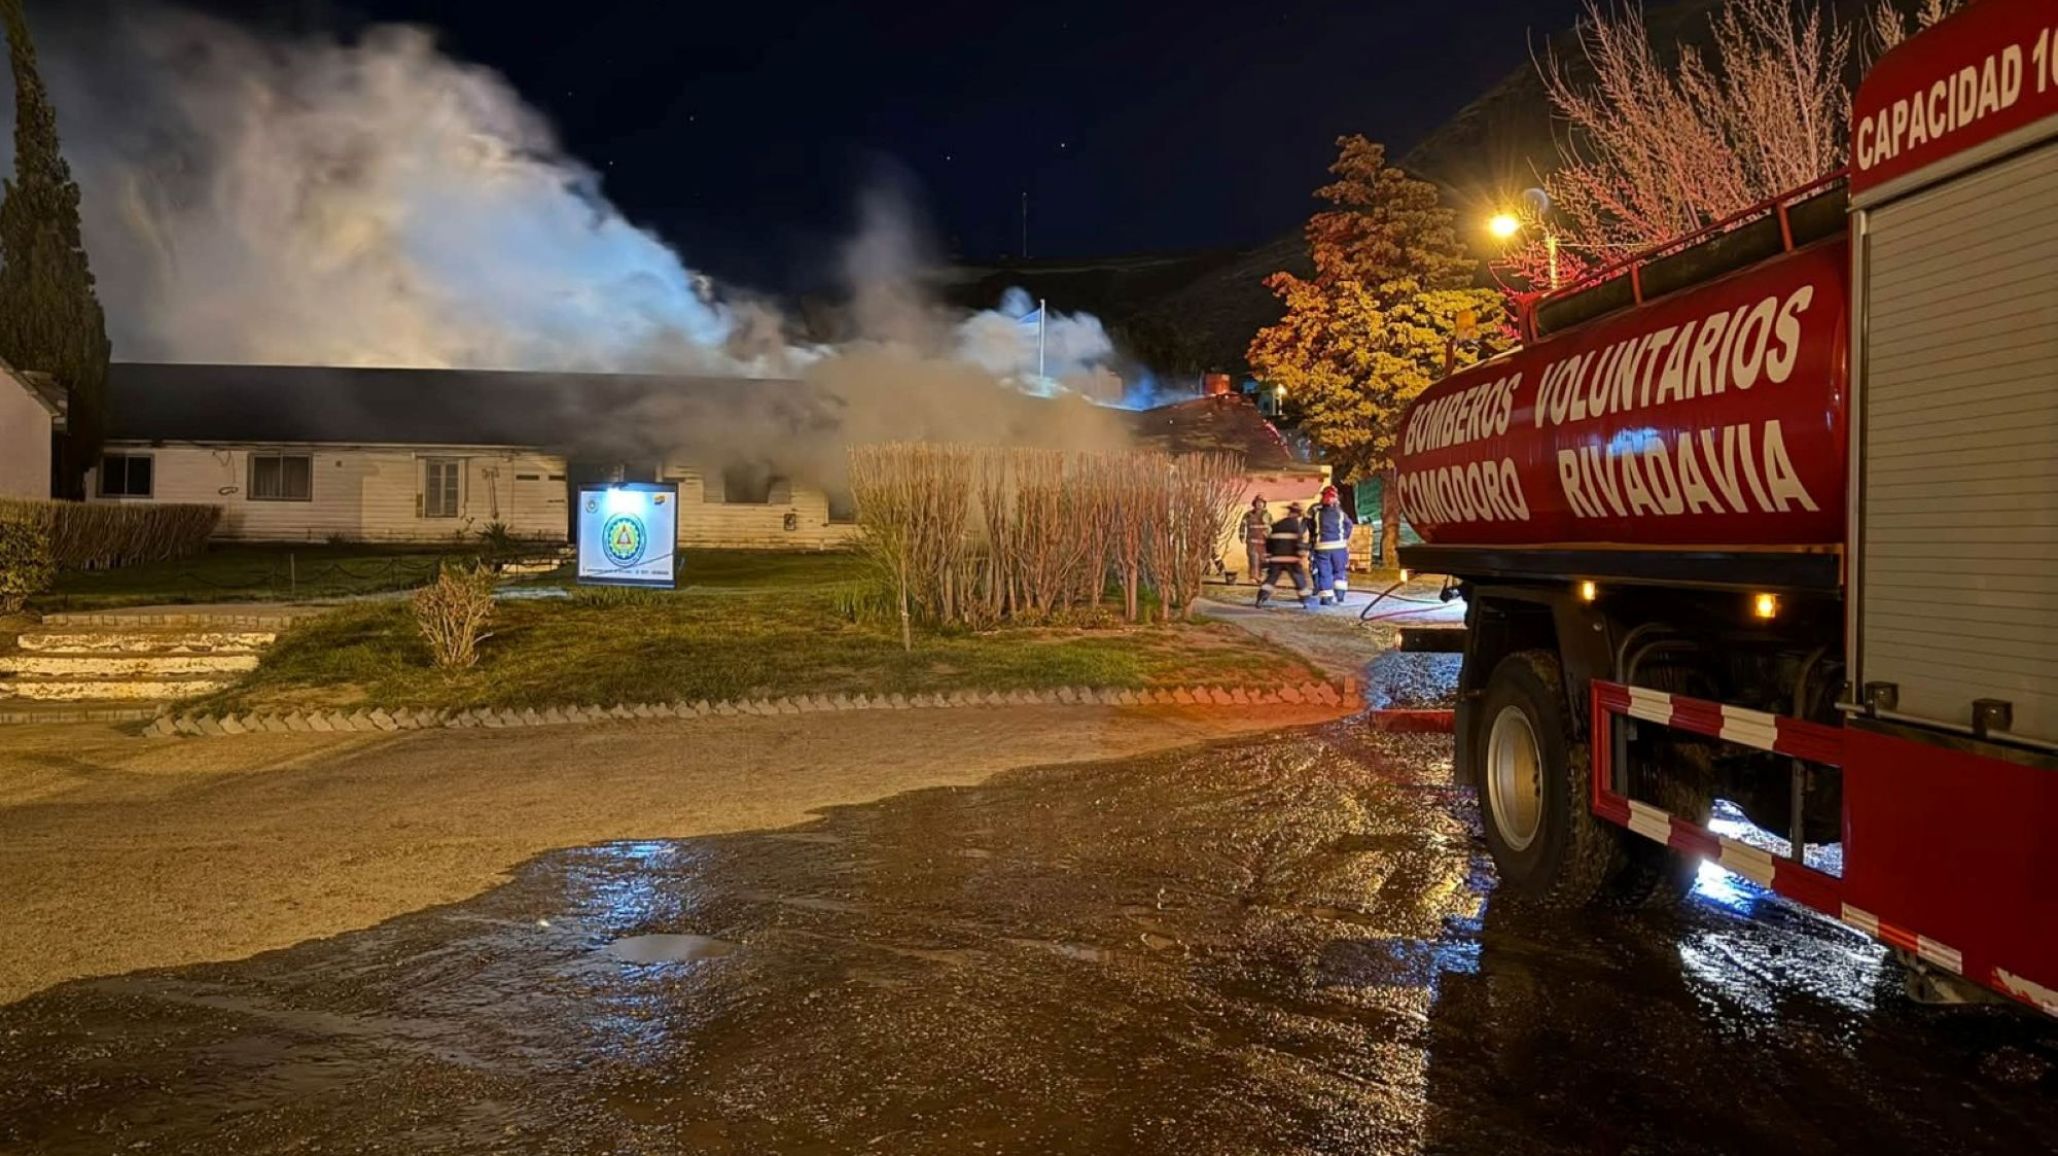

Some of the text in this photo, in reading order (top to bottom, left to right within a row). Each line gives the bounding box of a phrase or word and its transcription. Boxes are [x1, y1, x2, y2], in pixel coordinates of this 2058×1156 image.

[1857, 44, 2022, 170] CAPACIDAD
[1405, 285, 1814, 455] BOMBEROS VOLUNTARIOS
[1398, 420, 1820, 524] COMODORO RIVADAVIA
